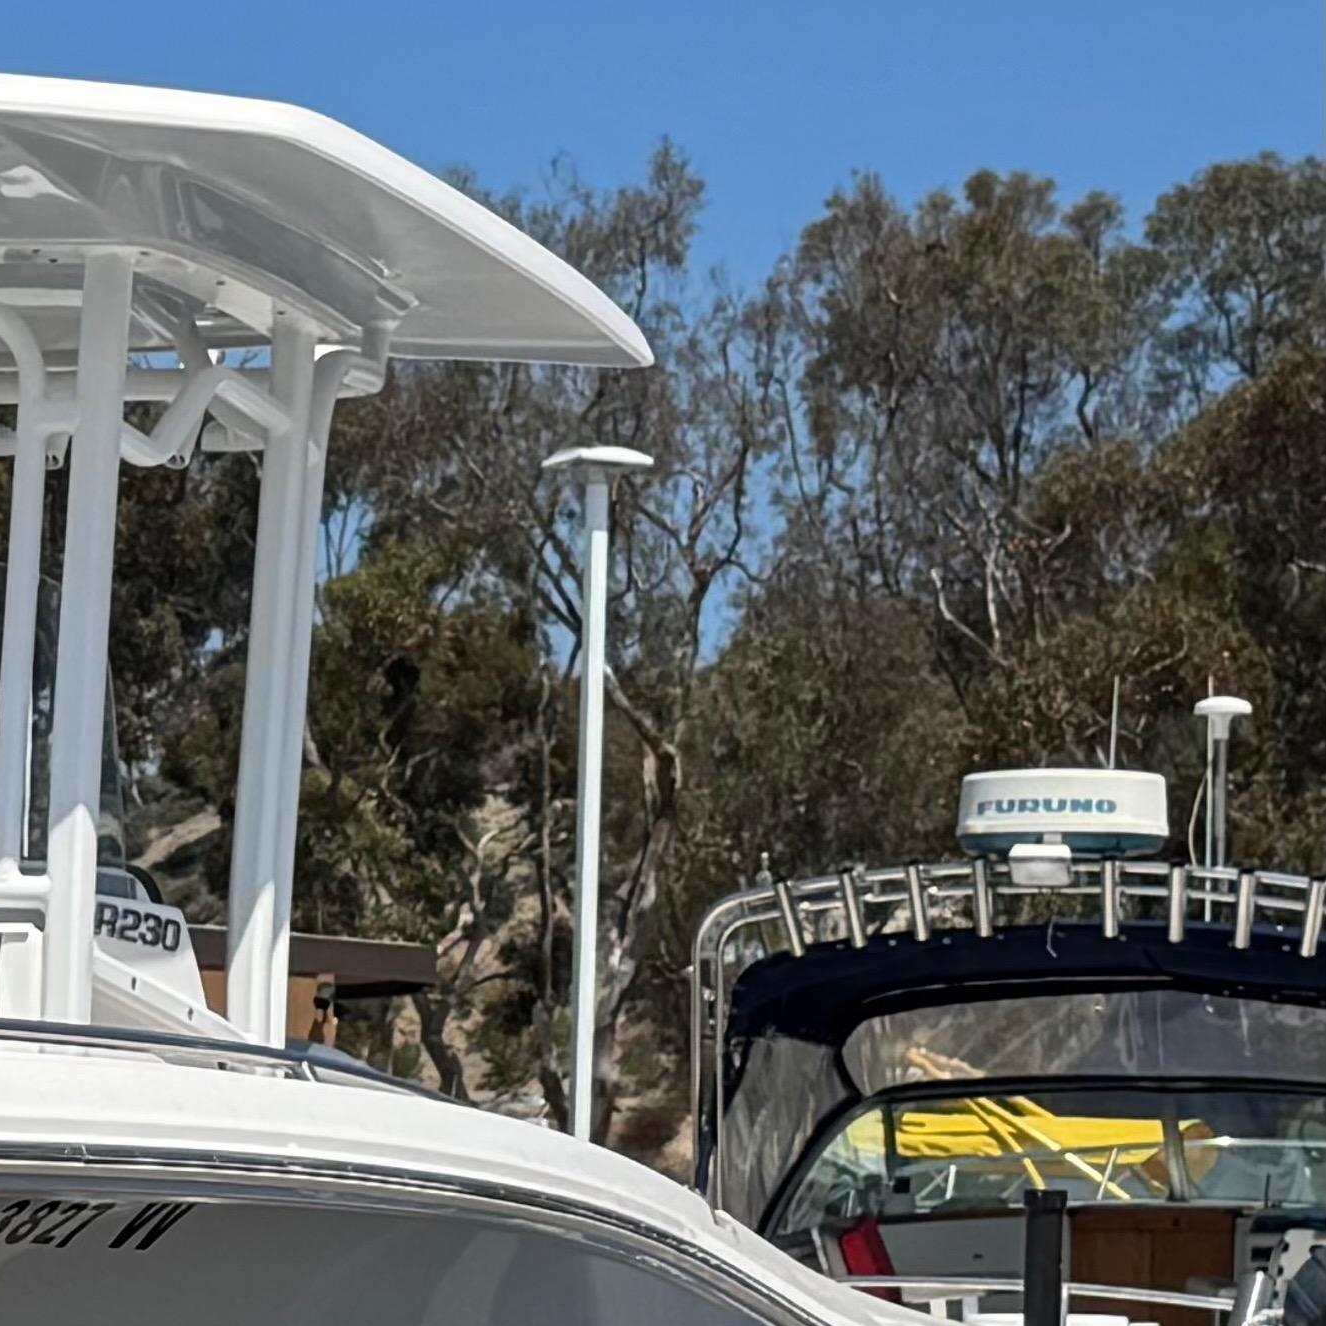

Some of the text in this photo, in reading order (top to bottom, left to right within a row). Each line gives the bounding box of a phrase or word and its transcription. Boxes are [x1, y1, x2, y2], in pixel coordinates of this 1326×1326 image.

[976, 797, 1118, 815] FURUNO
[95, 902, 181, 952] R230
[108, 1200, 198, 1251] W
